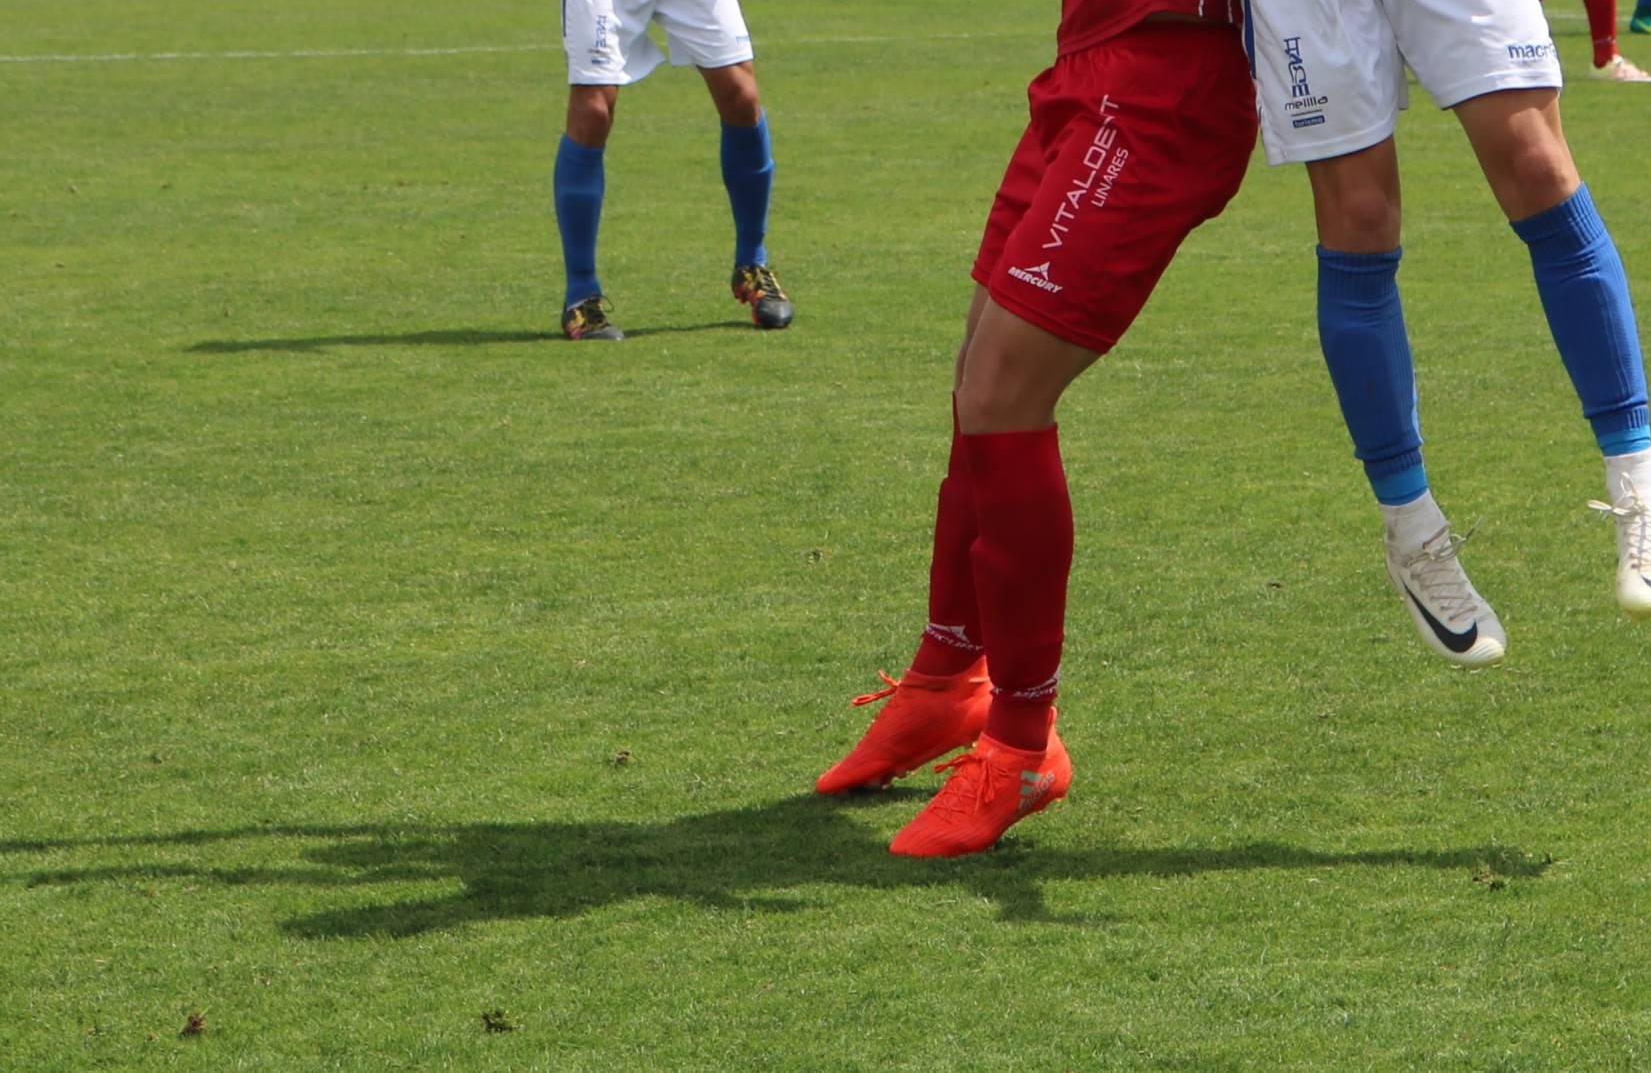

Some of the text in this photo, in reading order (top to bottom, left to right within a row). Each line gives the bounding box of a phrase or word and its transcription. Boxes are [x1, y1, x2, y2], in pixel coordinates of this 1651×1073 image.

[1284, 96, 1329, 111] melilla
[1091, 147, 1129, 207] LINARES
[1008, 266, 1063, 294] MERCURY
